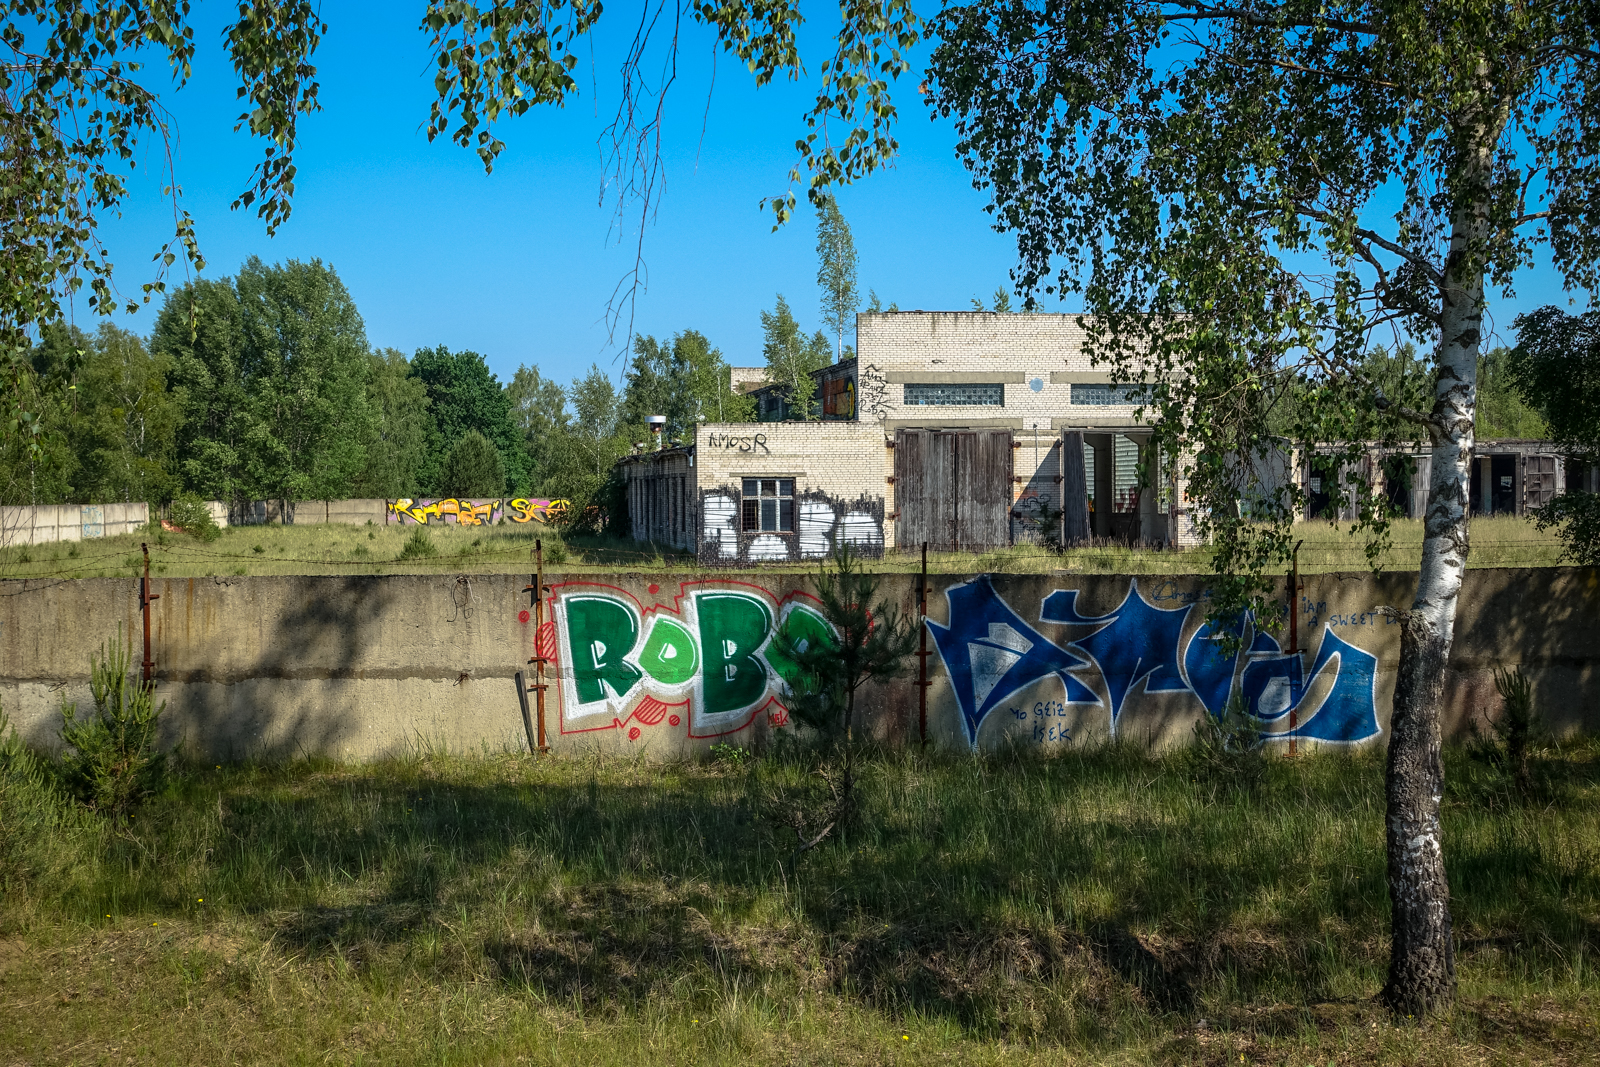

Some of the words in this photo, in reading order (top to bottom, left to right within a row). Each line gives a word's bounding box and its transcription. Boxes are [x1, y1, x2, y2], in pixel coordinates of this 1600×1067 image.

[553, 588, 846, 729] ROBO
[1308, 615, 1319, 627] A
[1329, 612, 1378, 627] SWEET
